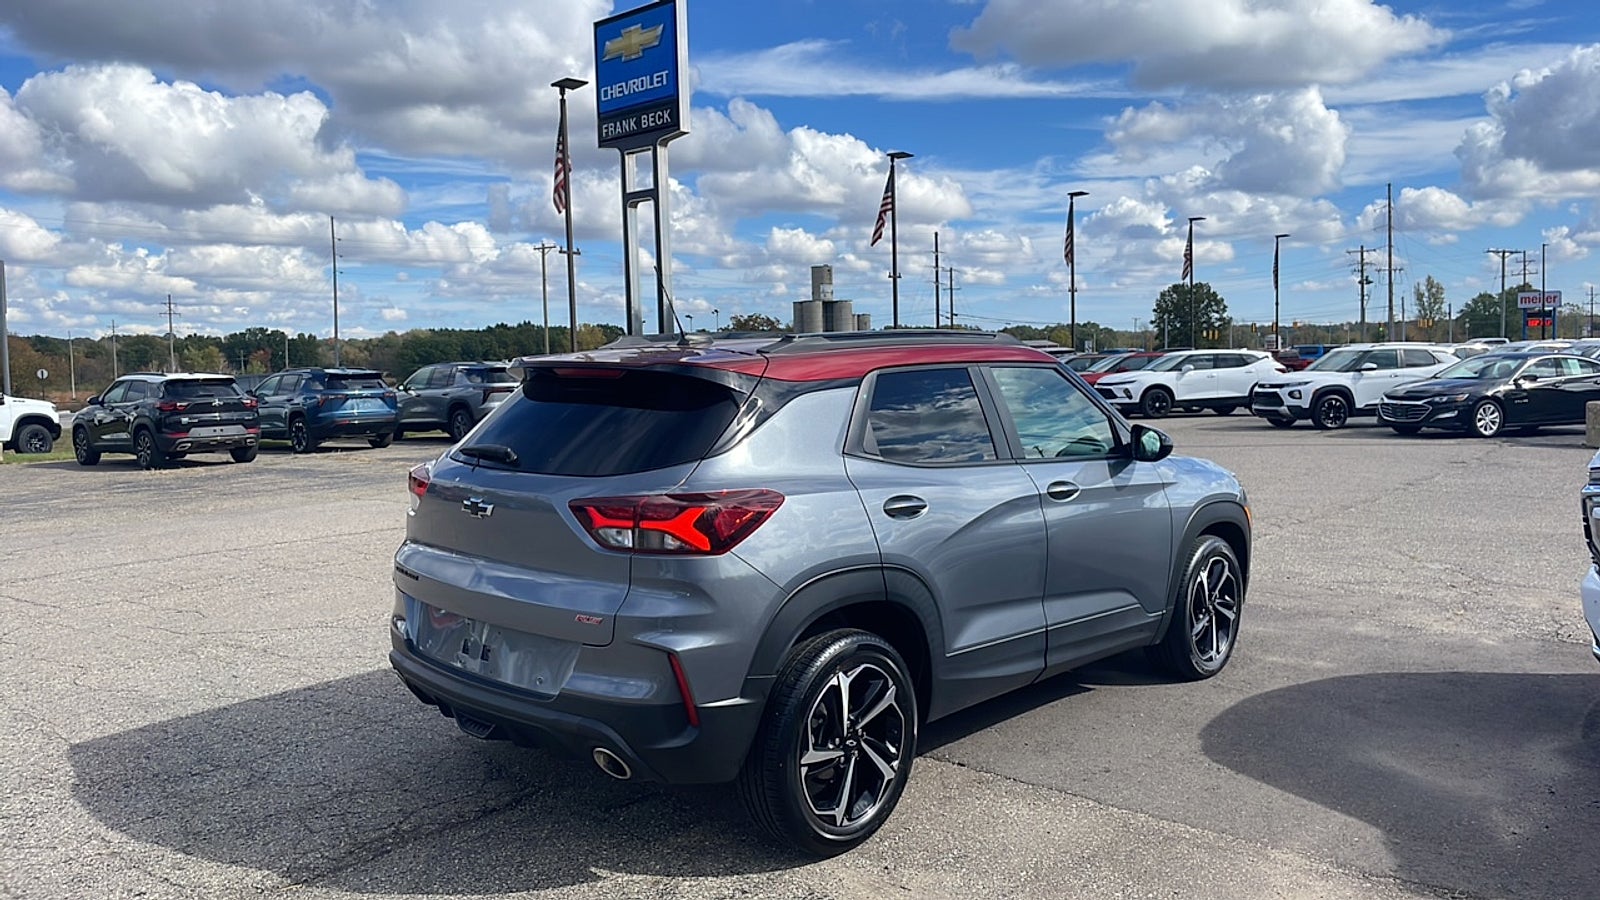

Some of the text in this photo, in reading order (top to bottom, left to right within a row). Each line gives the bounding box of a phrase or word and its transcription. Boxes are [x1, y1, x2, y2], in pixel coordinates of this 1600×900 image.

[601, 70, 669, 101] CHEVROLET
[602, 109, 671, 138] FRANK BECK
[1520, 292, 1558, 305] meier
